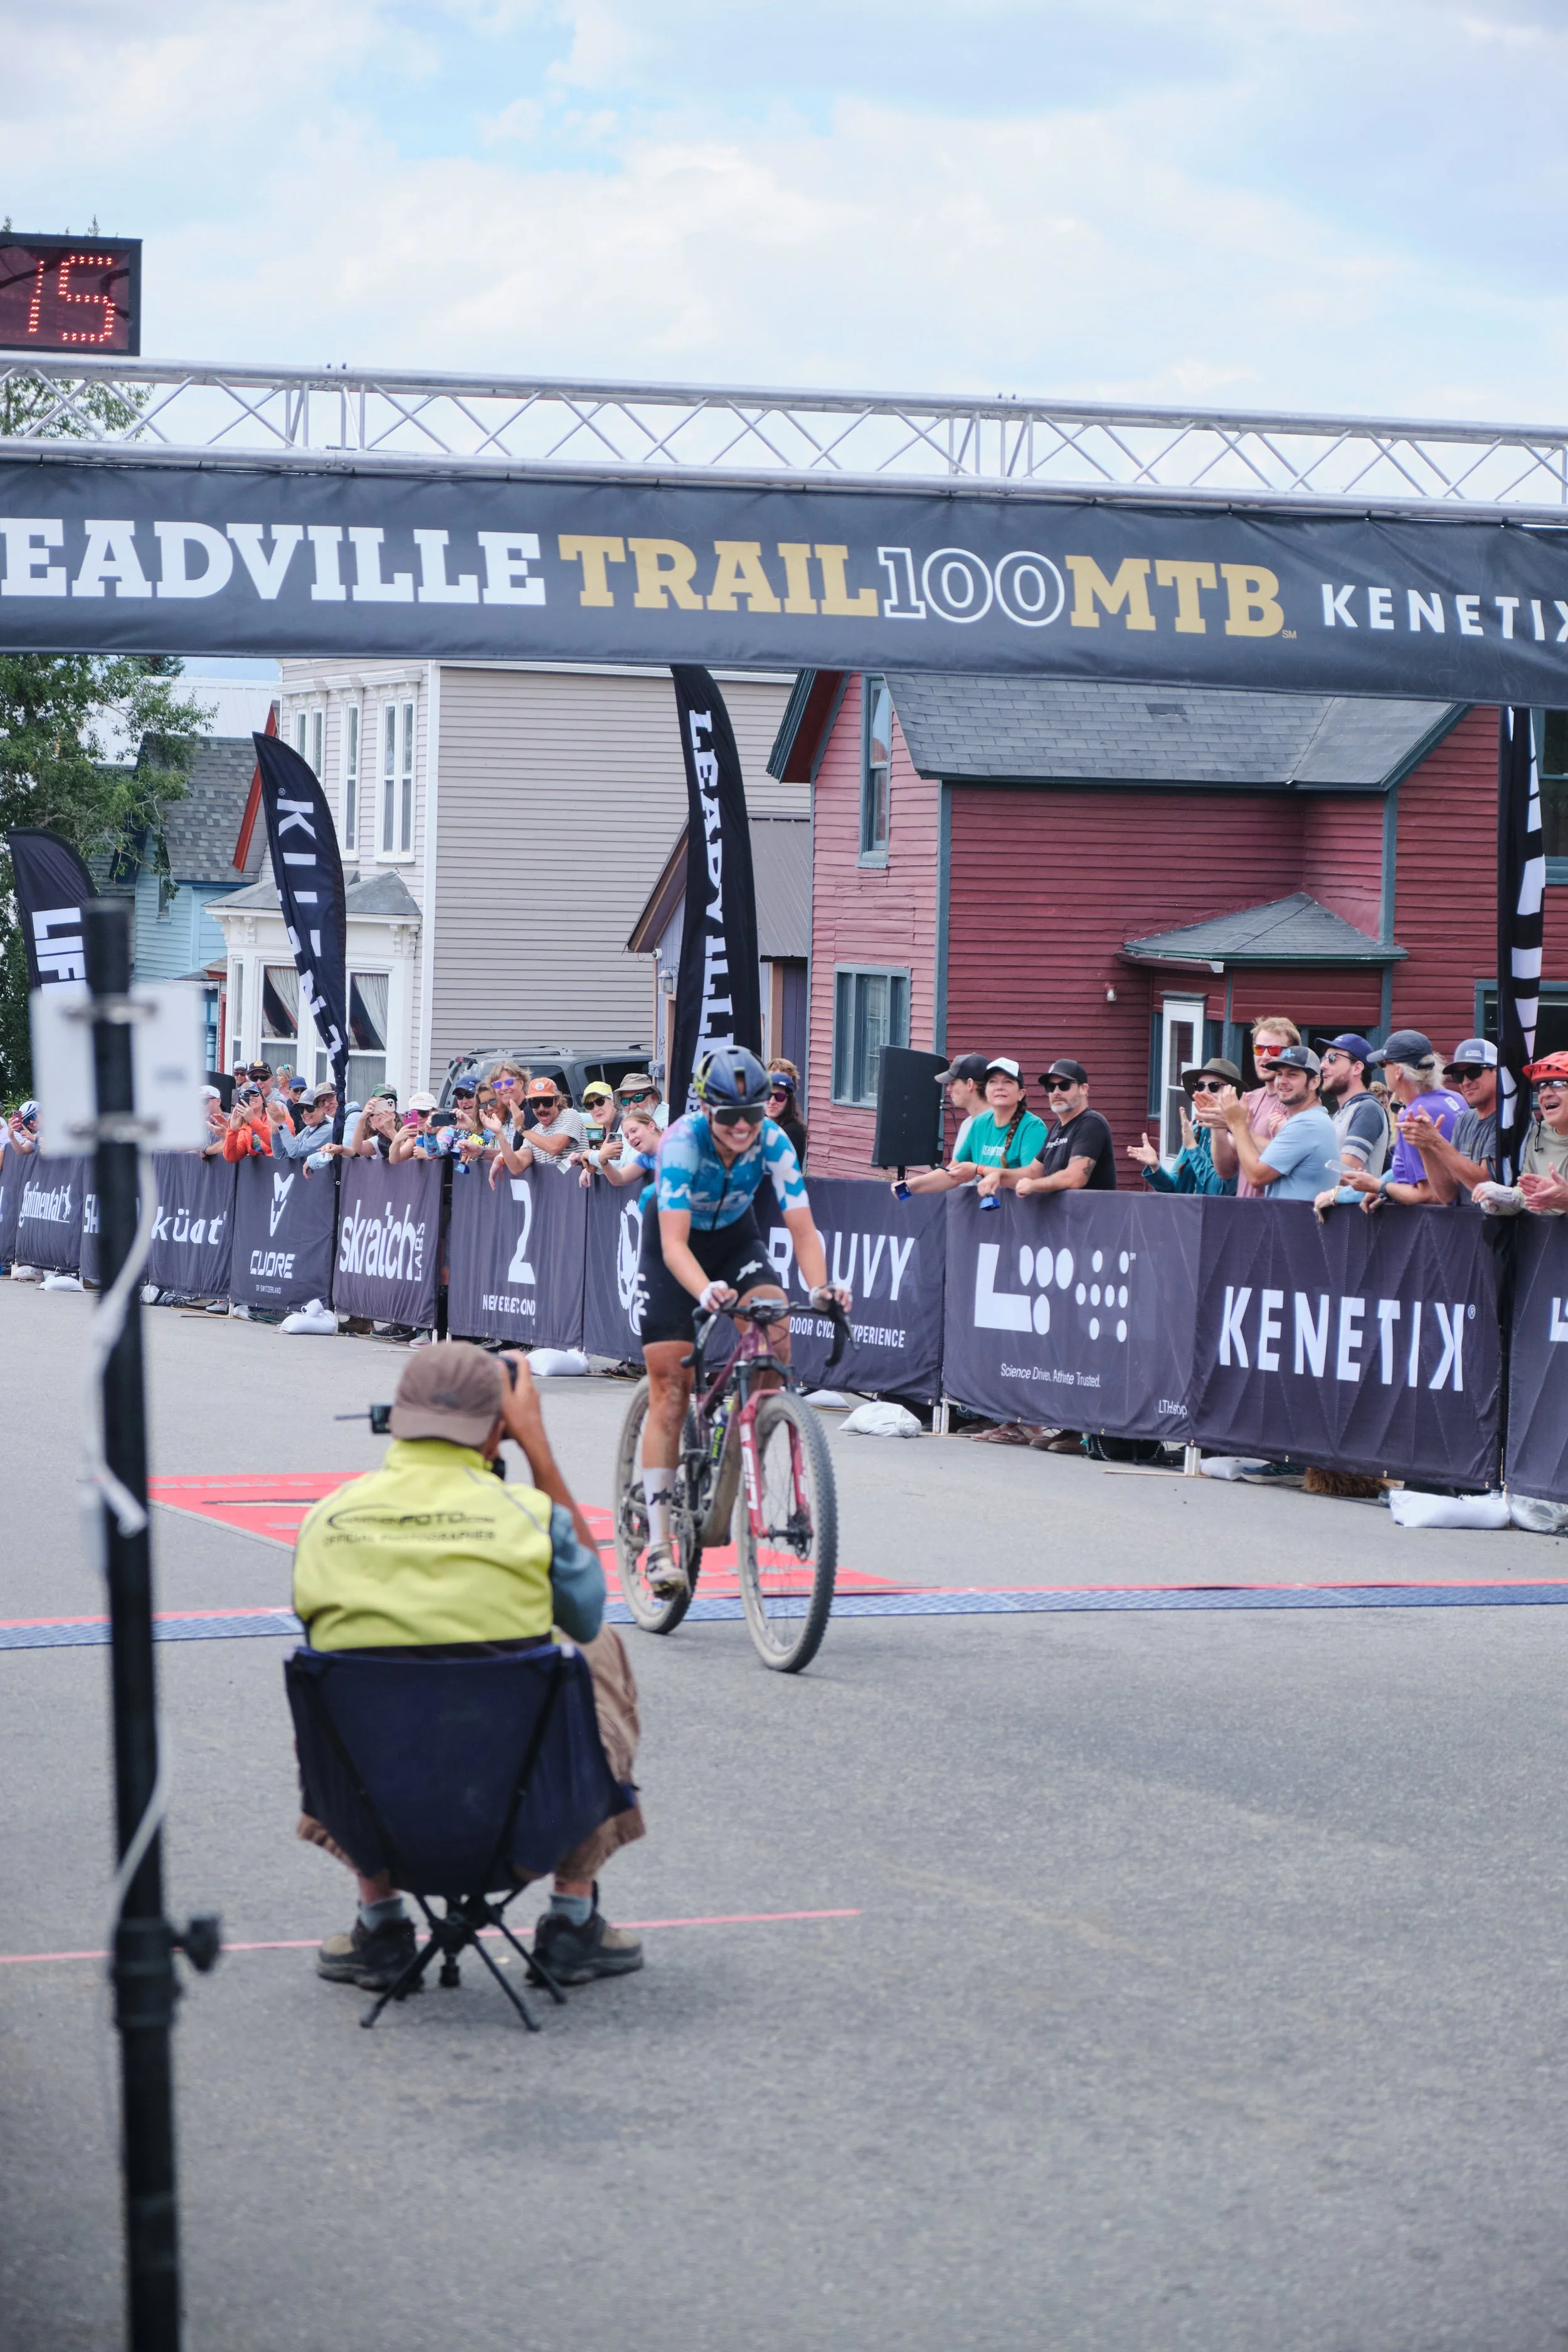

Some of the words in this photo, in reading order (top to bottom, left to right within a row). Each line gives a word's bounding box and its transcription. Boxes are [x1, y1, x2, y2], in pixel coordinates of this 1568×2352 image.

[28, 255, 116, 343] 15
[558, 534, 879, 617] TRAIL
[877, 546, 1066, 627] 100
[1064, 555, 1285, 638] MTB
[32, 907, 88, 999] LIF
[151, 1206, 223, 1244] küat
[339, 1199, 416, 1281] skratch
[414, 1222, 425, 1281] LABS
[250, 1250, 295, 1279] CUORE
[1000, 1363, 1032, 1379] Science
[1076, 1372, 1101, 1387] Trusted.
